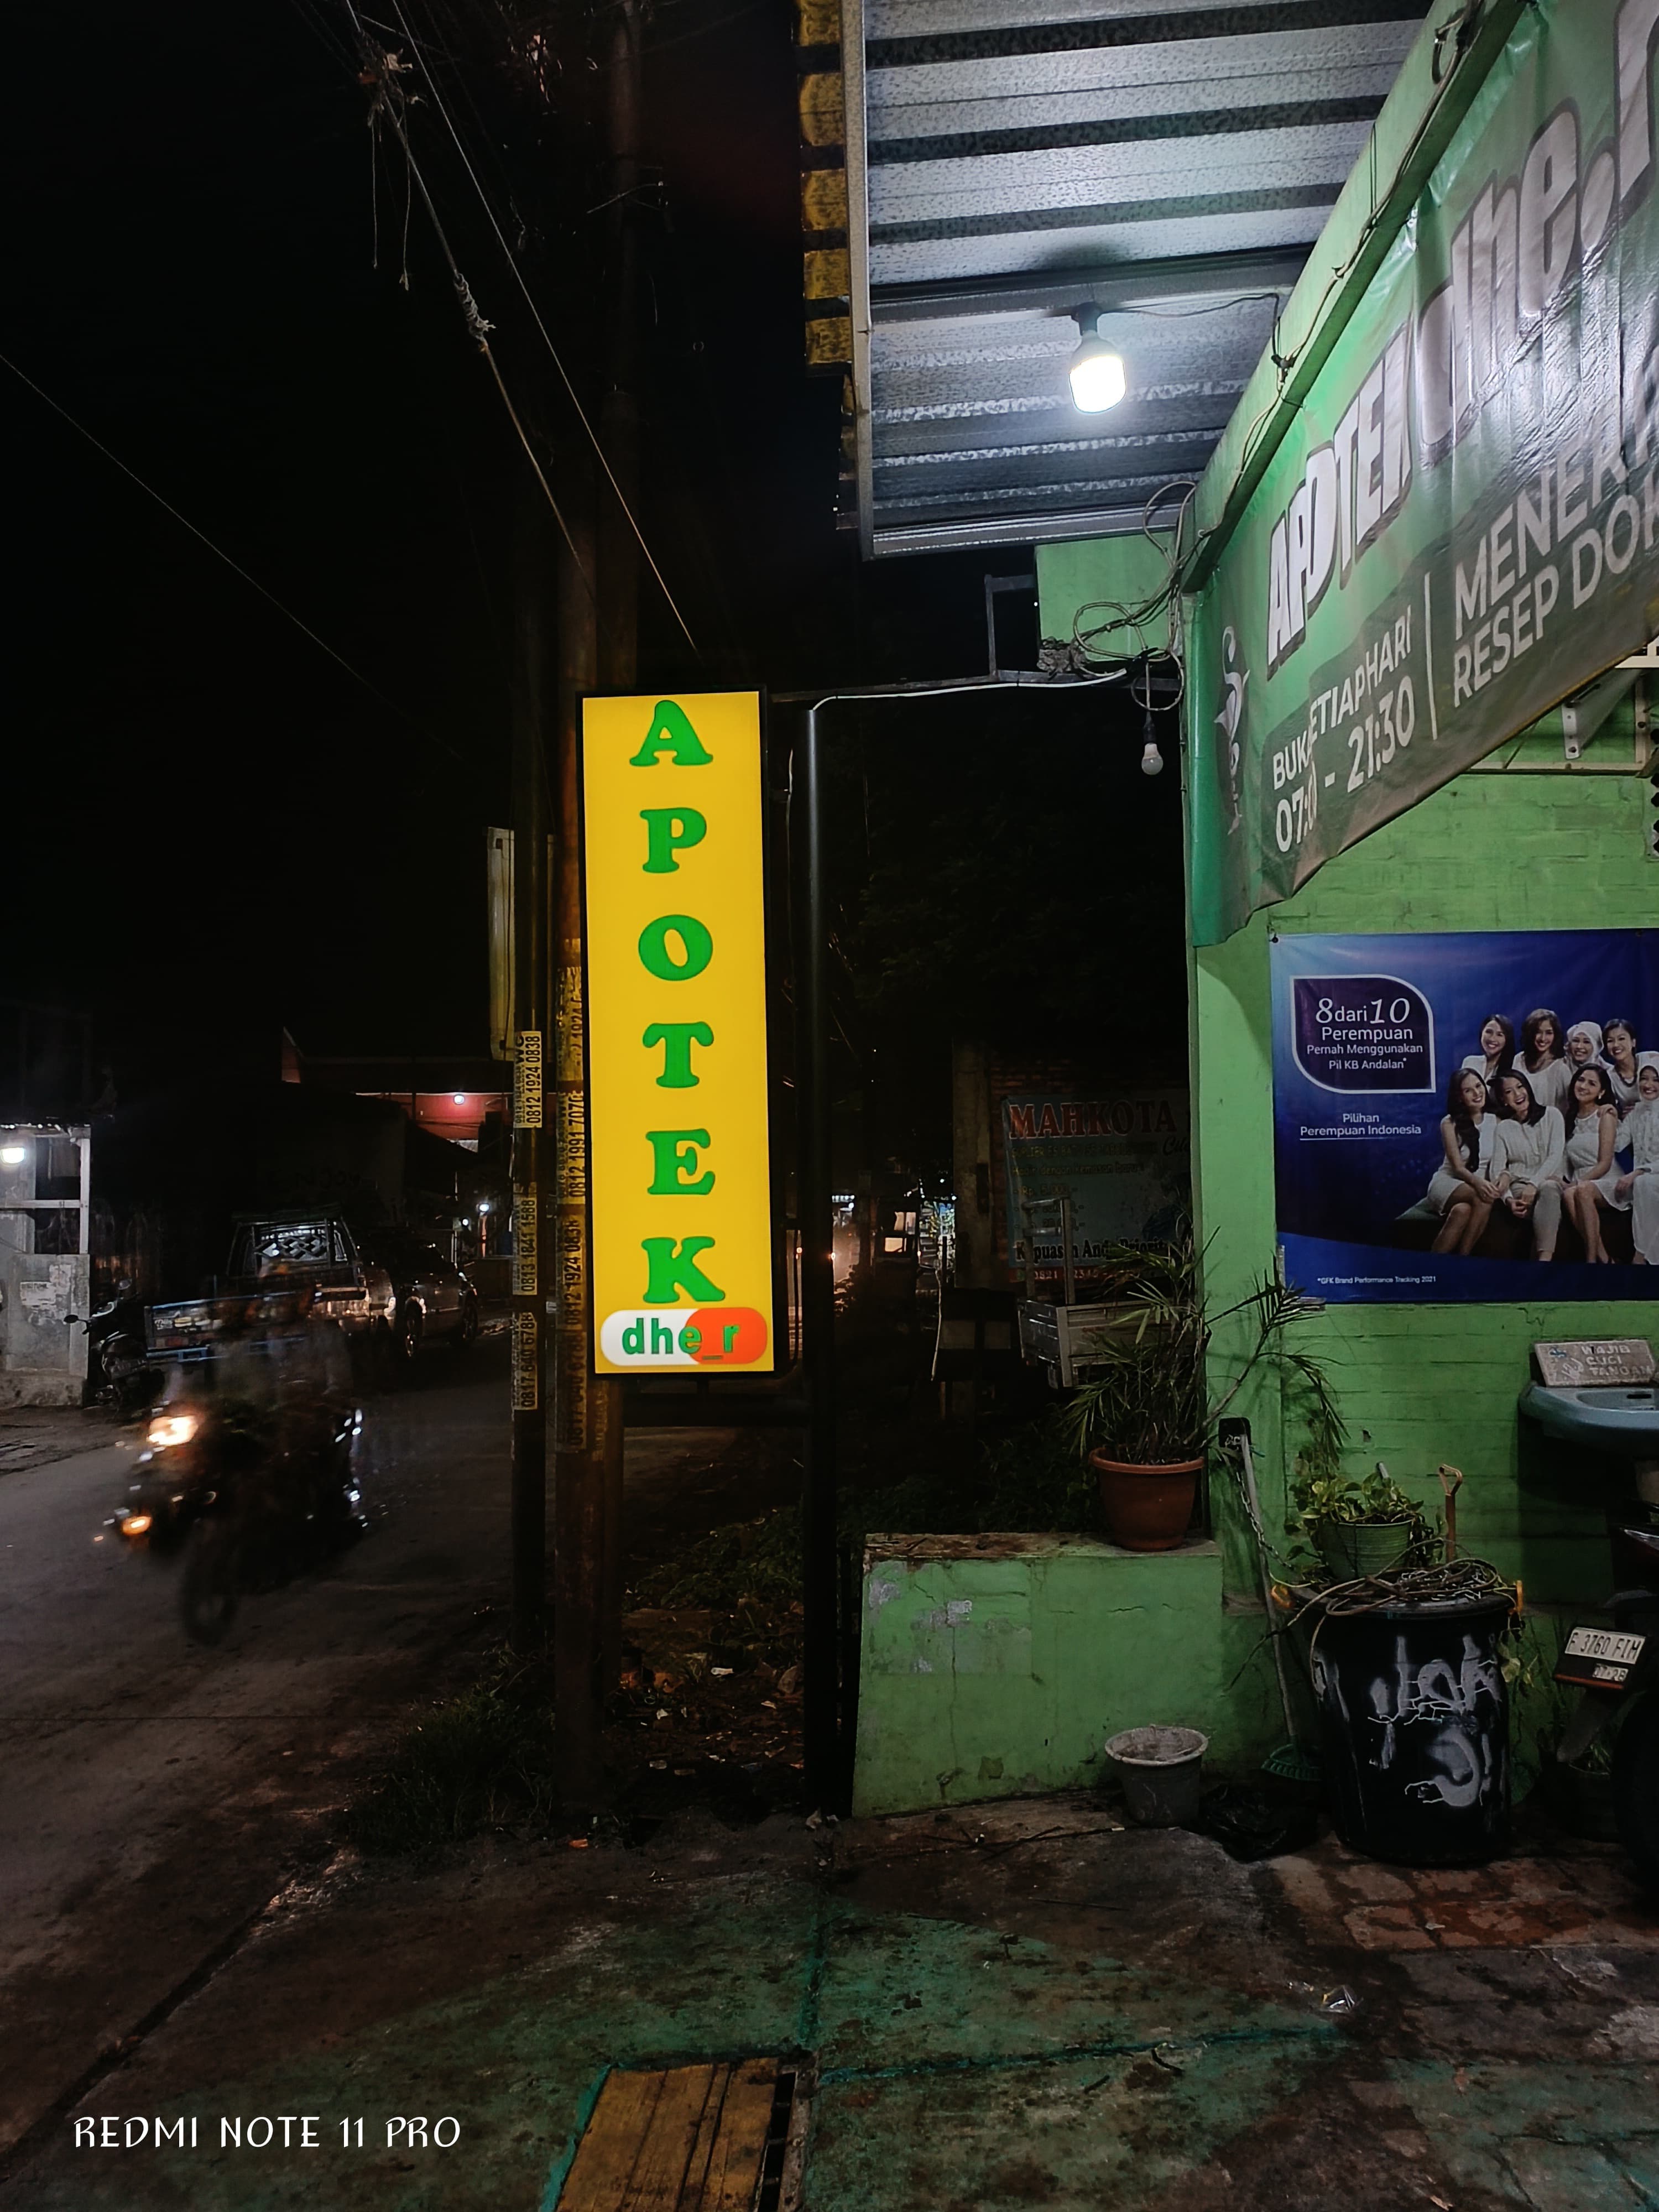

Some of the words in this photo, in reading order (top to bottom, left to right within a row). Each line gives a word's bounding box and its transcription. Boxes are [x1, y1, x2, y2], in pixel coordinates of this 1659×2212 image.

[1454, 564, 1560, 708] RESEP
[1347, 675, 1415, 793] 21:30
[629, 700, 726, 1304] APOTEK
[1316, 998, 1333, 1024] 8
[1334, 1005, 1367, 1022] dari
[1370, 998, 1410, 1024] 10
[1322, 1026, 1413, 1044] Perempuan
[524, 1036, 541, 1063] 0838
[1307, 1044, 1344, 1054] Pernah
[1347, 1043, 1423, 1056] Menggunakan
[1329, 1060, 1342, 1070] Pil
[1344, 1060, 1359, 1070] KB
[525, 1066, 541, 1093] 1924
[525, 1097, 541, 1124] 0812
[1008, 1098, 1178, 1140] MAHKOTA
[1342, 1113, 1380, 1123] Pilihan
[1300, 1126, 1365, 1139] Perempuan
[1368, 1124, 1422, 1135] Indonesia
[568, 1132, 585, 1161] 1991
[568, 1166, 585, 1198] 0812
[521, 1200, 536, 1227] 1588
[521, 1263, 536, 1292] 0813
[564, 1256, 581, 1287] 1924
[1354, 1275, 1394, 1284] Performance
[1394, 1275, 1421, 1284] Tracking
[1580, 1344, 1631, 1355] WAJIB
[1585, 1355, 1622, 1365] CUCI
[520, 1376, 535, 1407] 0817
[1580, 1634, 1611, 1655] 3760
